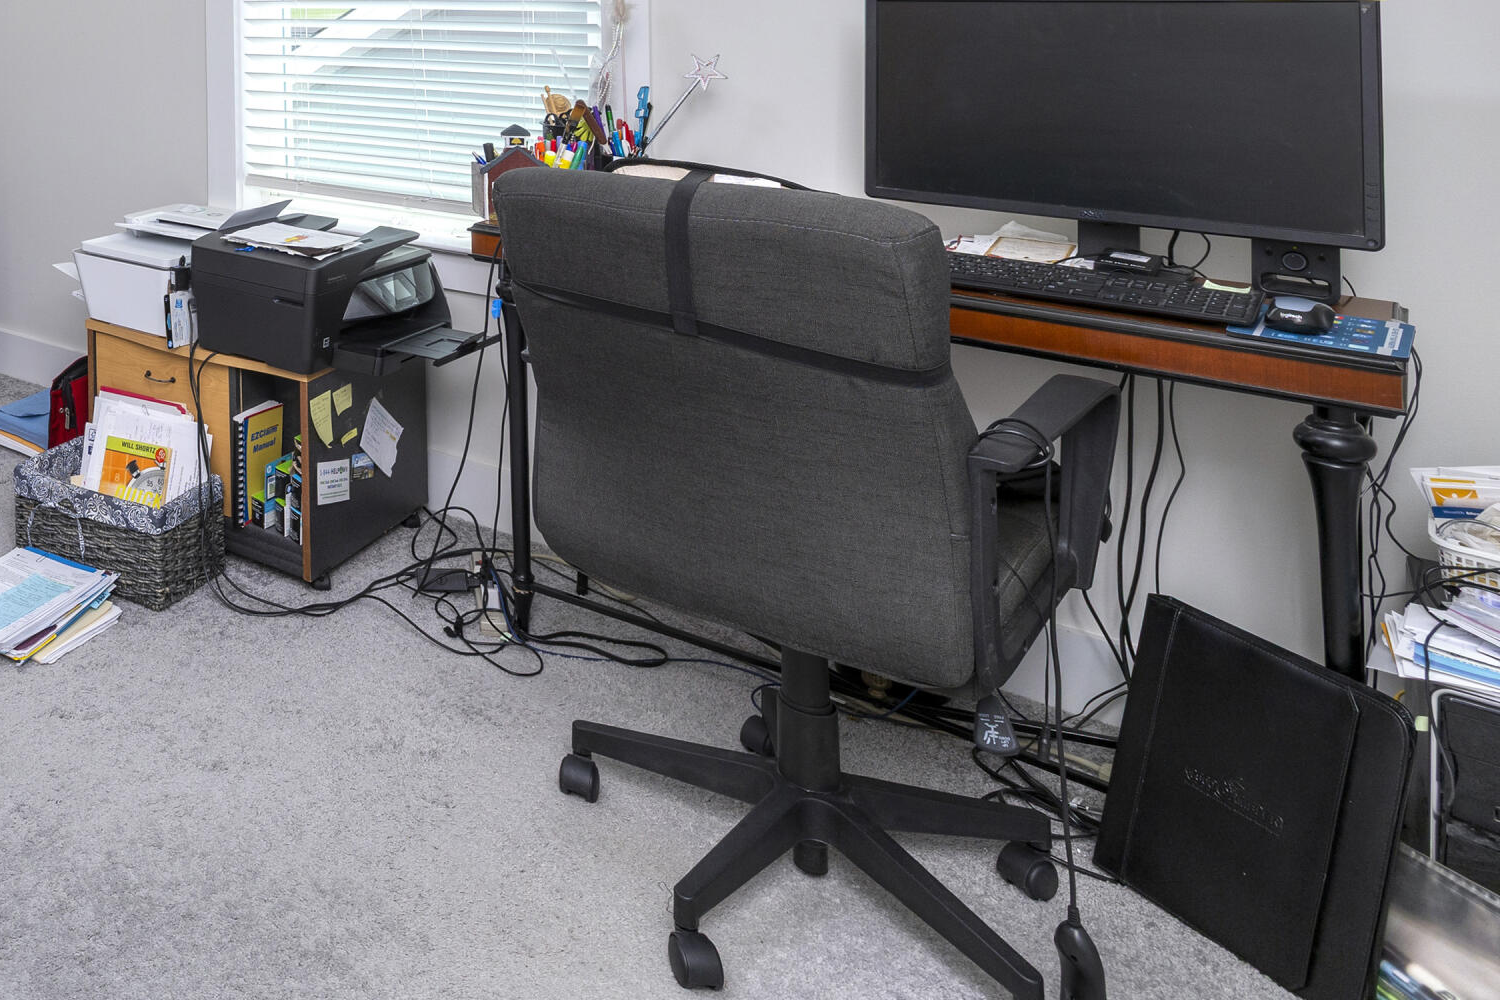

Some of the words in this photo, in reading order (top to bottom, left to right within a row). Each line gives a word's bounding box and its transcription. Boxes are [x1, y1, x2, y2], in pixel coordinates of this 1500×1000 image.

[121, 441, 134, 450] WILL
[135, 444, 157, 455] SHORTZ
[252, 437, 277, 453] Manual
